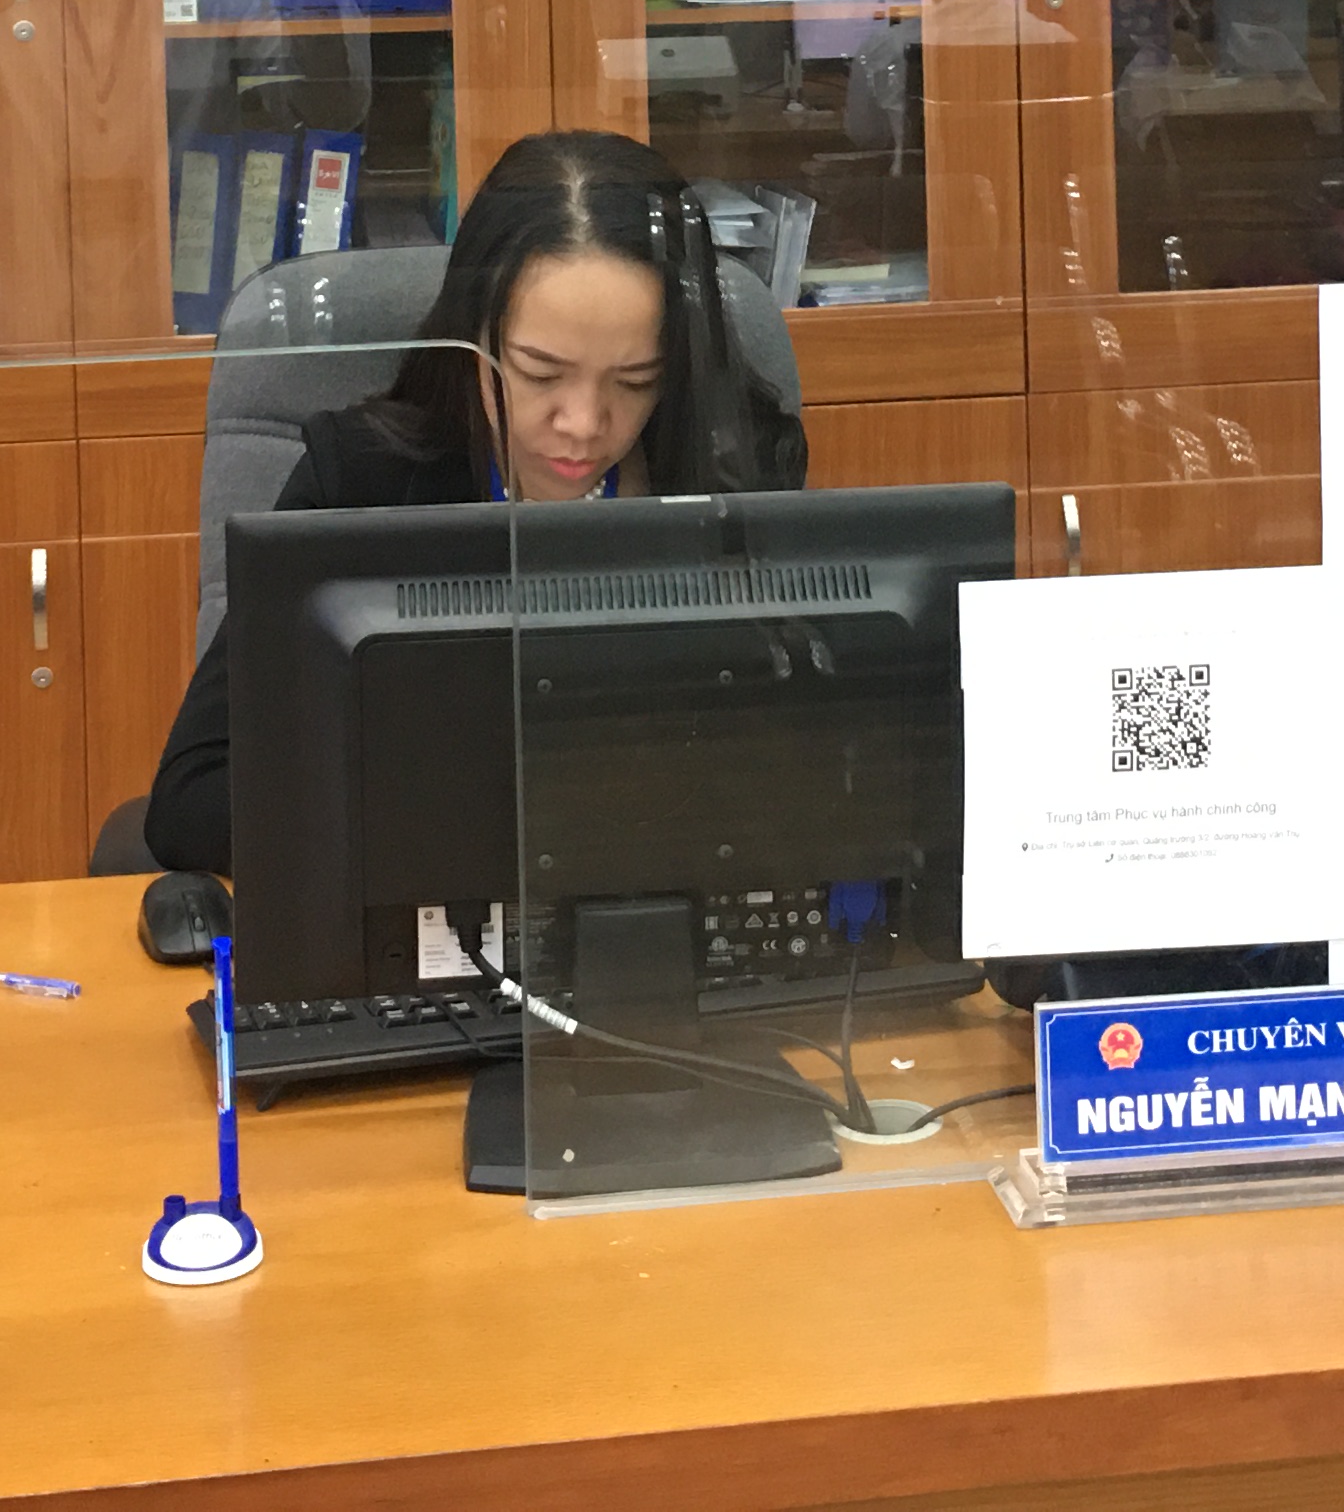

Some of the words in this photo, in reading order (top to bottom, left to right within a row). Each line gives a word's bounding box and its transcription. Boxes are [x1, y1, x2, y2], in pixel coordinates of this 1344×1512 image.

[1046, 810, 1083, 826] Trung
[1086, 808, 1111, 822] tâm
[1115, 807, 1149, 822] Phục
[1153, 808, 1168, 822] vụ
[1171, 803, 1203, 819] hành
[1206, 801, 1243, 817] chính
[1245, 801, 1278, 817] công
[1187, 1017, 1327, 1057] CHUYÊN
[1075, 1076, 1245, 1136] NGUYỄN
